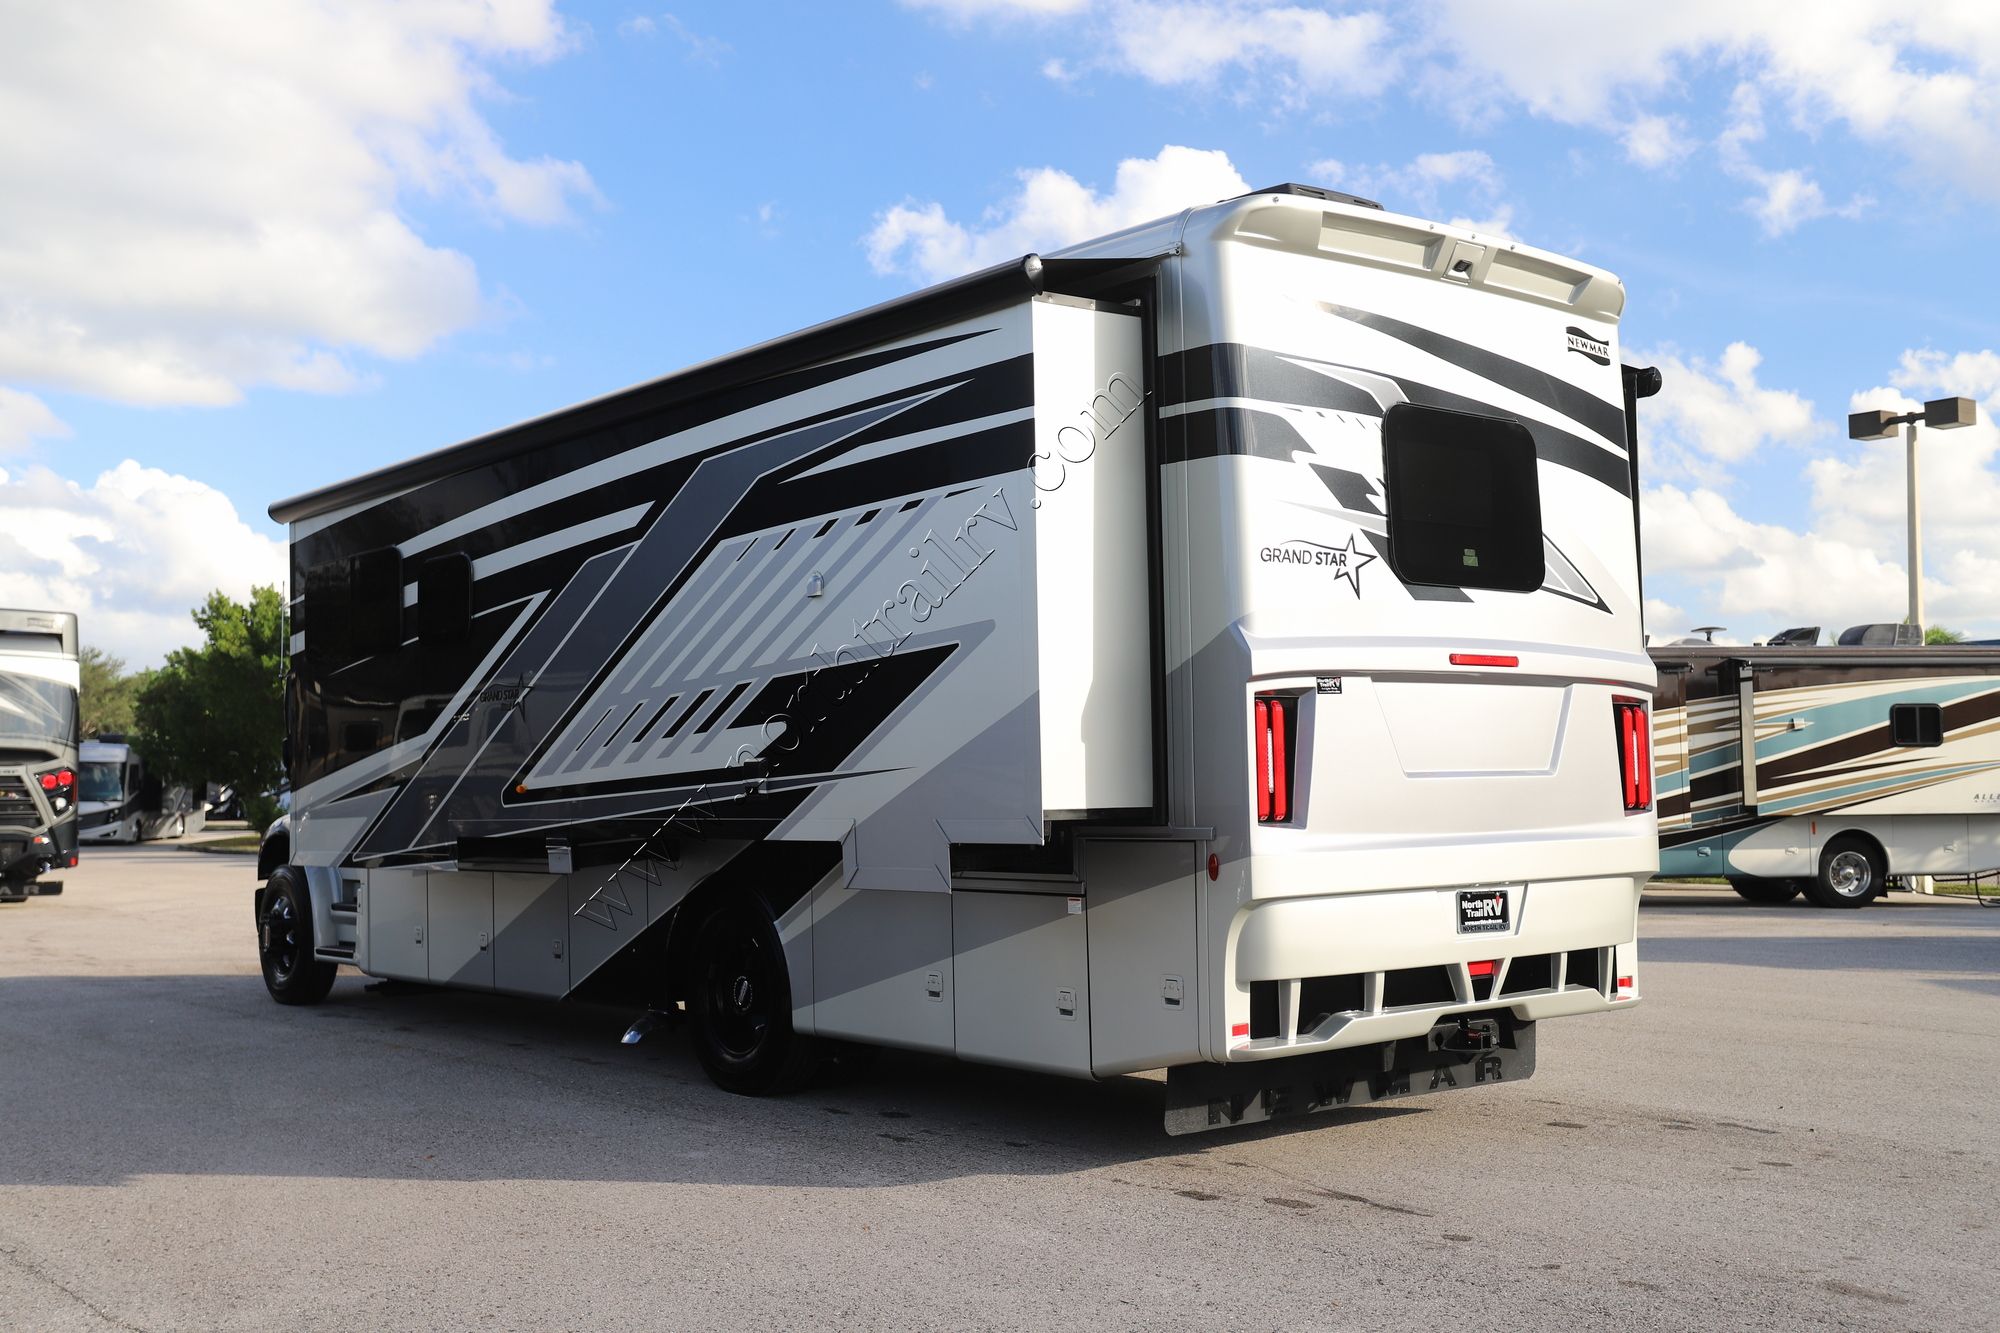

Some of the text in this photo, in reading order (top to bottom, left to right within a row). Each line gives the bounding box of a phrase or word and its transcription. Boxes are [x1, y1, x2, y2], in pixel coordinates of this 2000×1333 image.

[1567, 336, 1609, 357] NEWMAR
[1260, 547, 1347, 567] GRAND STAR
[480, 689, 519, 702] GRAND STAR
[1461, 900, 1483, 909] North
[1466, 898, 1503, 918] Trail RV
[1207, 1056, 1503, 1126] NEWMAR
